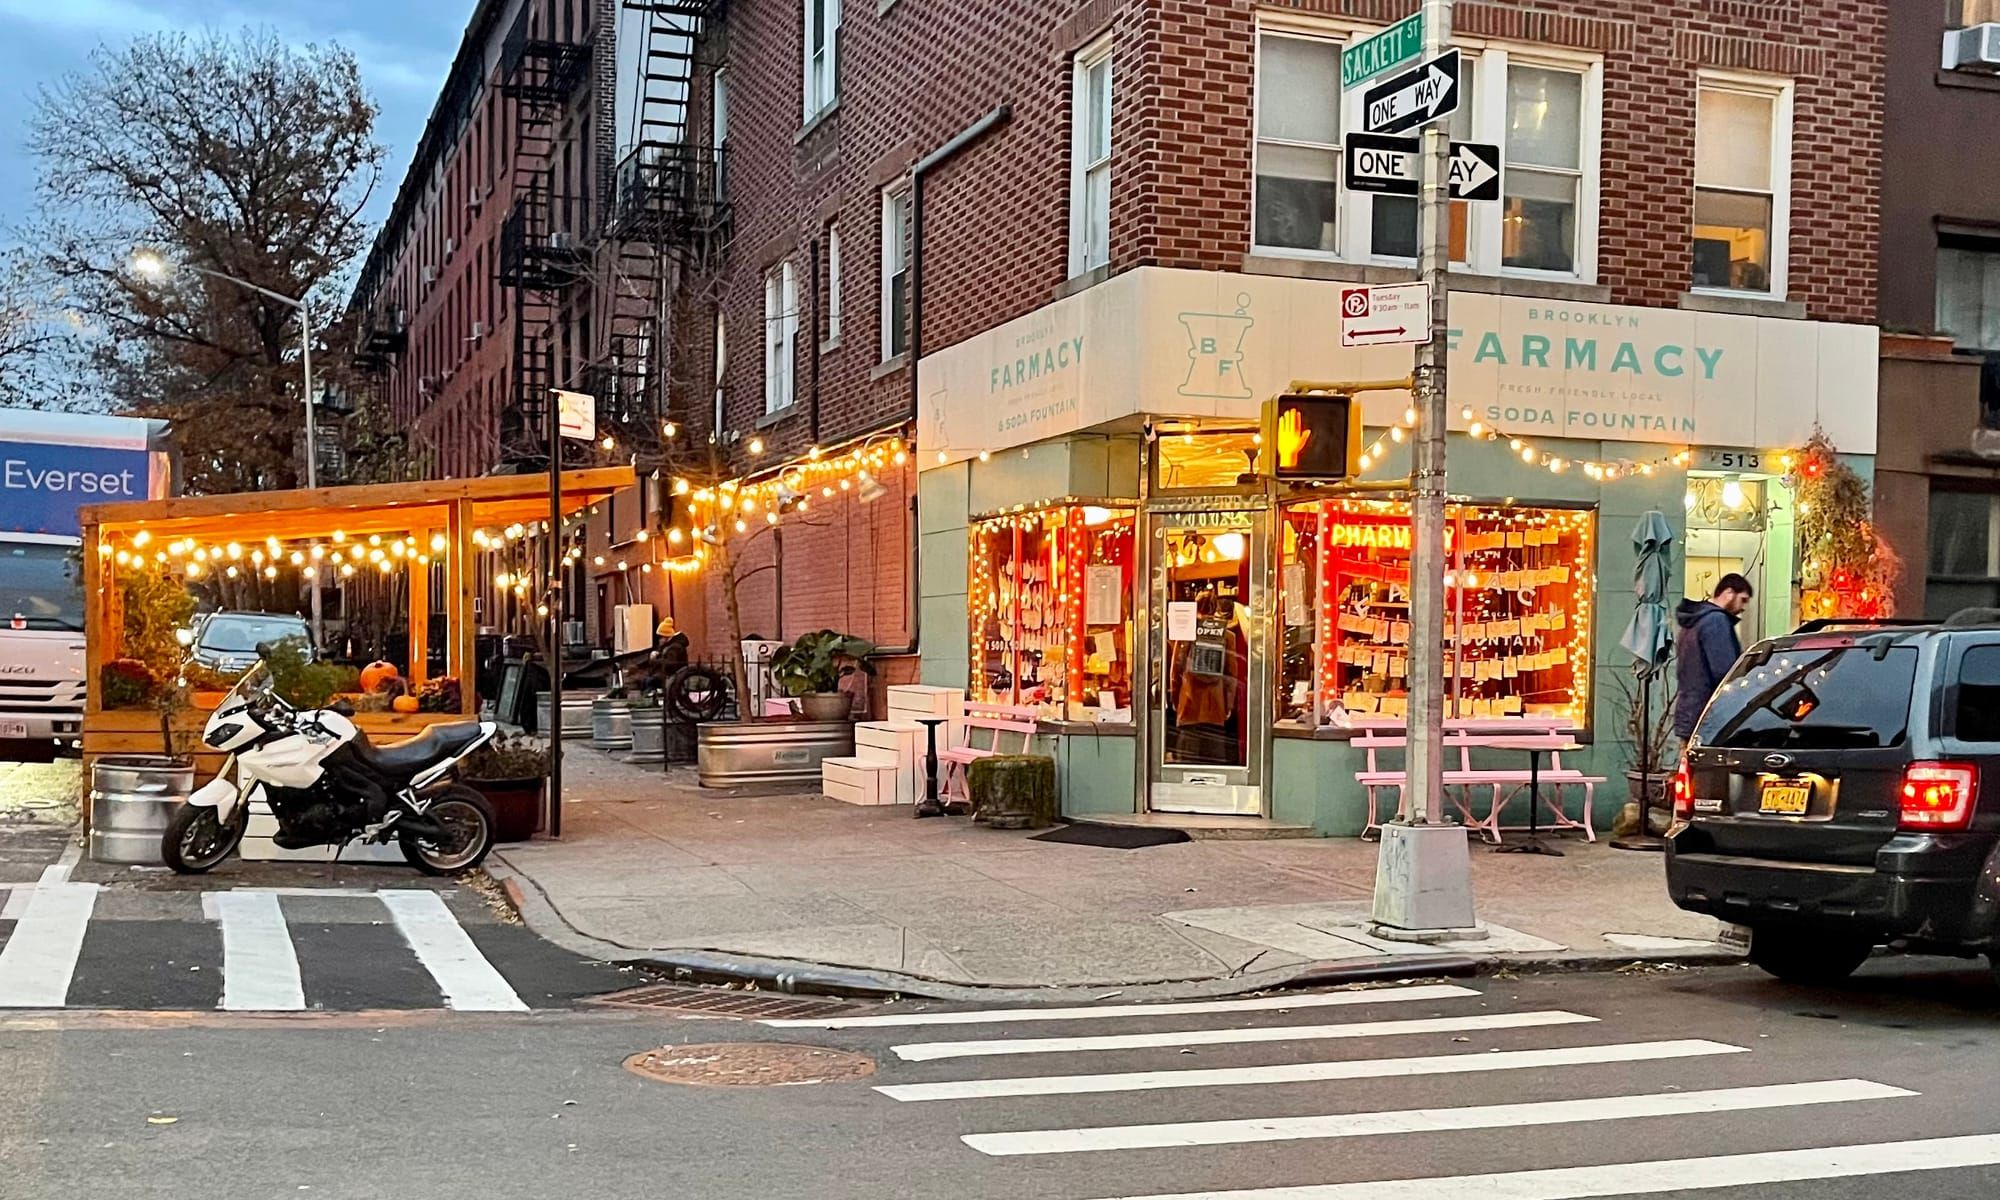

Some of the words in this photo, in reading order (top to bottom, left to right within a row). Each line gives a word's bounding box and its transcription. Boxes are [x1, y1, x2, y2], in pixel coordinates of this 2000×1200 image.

[1344, 27, 1404, 85] SACKETT
[1407, 19, 1420, 39] ST
[1372, 95, 1398, 126] ONE
[1414, 75, 1442, 108] WAY
[1359, 151, 1404, 177] ONE
[1449, 160, 1479, 182] AY
[1372, 293, 1401, 302] Tuesday
[1528, 308, 1641, 328] BROOKLYN
[1200, 337, 1216, 354] B
[990, 335, 1084, 394] FARMACY
[1219, 359, 1233, 376] F
[1499, 383, 1542, 394] FRESH
[1549, 386, 1616, 400] FRIENDLY
[1622, 391, 1664, 403] LOCAL
[1005, 412, 1028, 431] SODA
[1030, 398, 1076, 423] FOUNTAIN
[1486, 406, 1555, 425] SODA
[1567, 411, 1696, 433] FOUNTAIN
[1722, 453, 1760, 468] 513
[5, 459, 135, 495] Everset
[1331, 523, 1455, 549] PHARMY
[1196, 627, 1225, 637] OPEN
[0, 664, 36, 674] UZU
